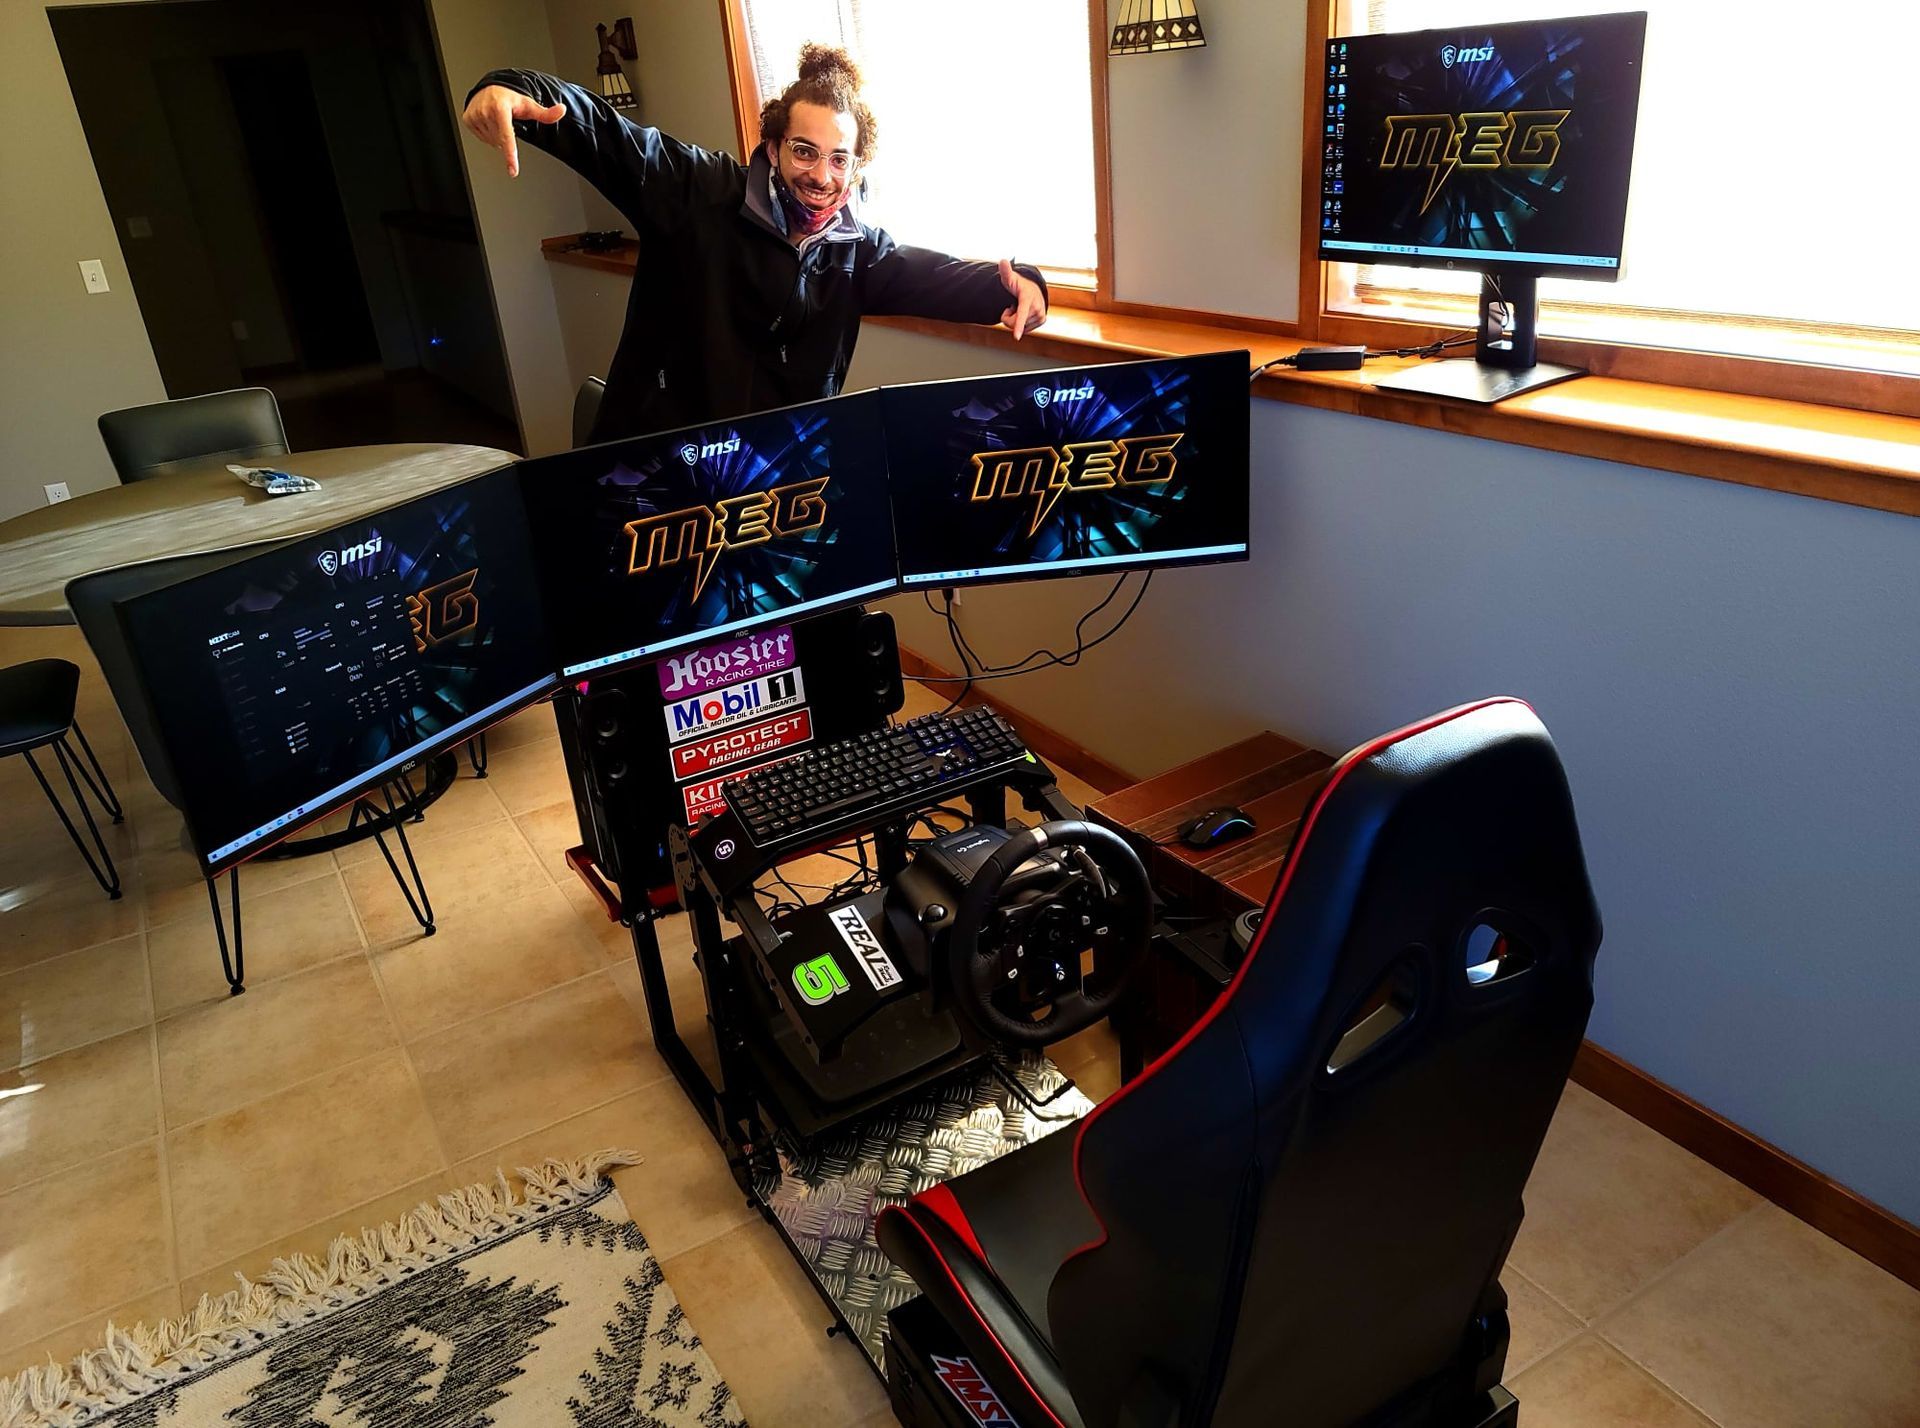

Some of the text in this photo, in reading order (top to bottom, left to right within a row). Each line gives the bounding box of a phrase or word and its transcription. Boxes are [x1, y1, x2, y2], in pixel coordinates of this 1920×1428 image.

[1456, 45, 1495, 63] msi
[1379, 109, 1572, 216] MEG
[1053, 386, 1095, 403] msi
[701, 437, 741, 459] msi
[970, 432, 1185, 539] MEG
[341, 536, 383, 566] msi
[623, 476, 830, 607] MEG
[665, 632, 790, 692] Hoosier
[705, 659, 785, 687] RACING TIRE
[673, 677, 786, 731] Mobil 1
[678, 724, 708, 737] OFFICIAL
[710, 715, 735, 727] MOTOR
[736, 712, 747, 720] OIL
[756, 697, 797, 714] LUBRICANTS
[681, 716, 802, 764] PYROTECT
[709, 737, 781, 767] RACING GEAR
[691, 801, 727, 816] RACING
[838, 907, 889, 987] REAL
[792, 952, 850, 1005] 5
[930, 1354, 1020, 1428] AMS
